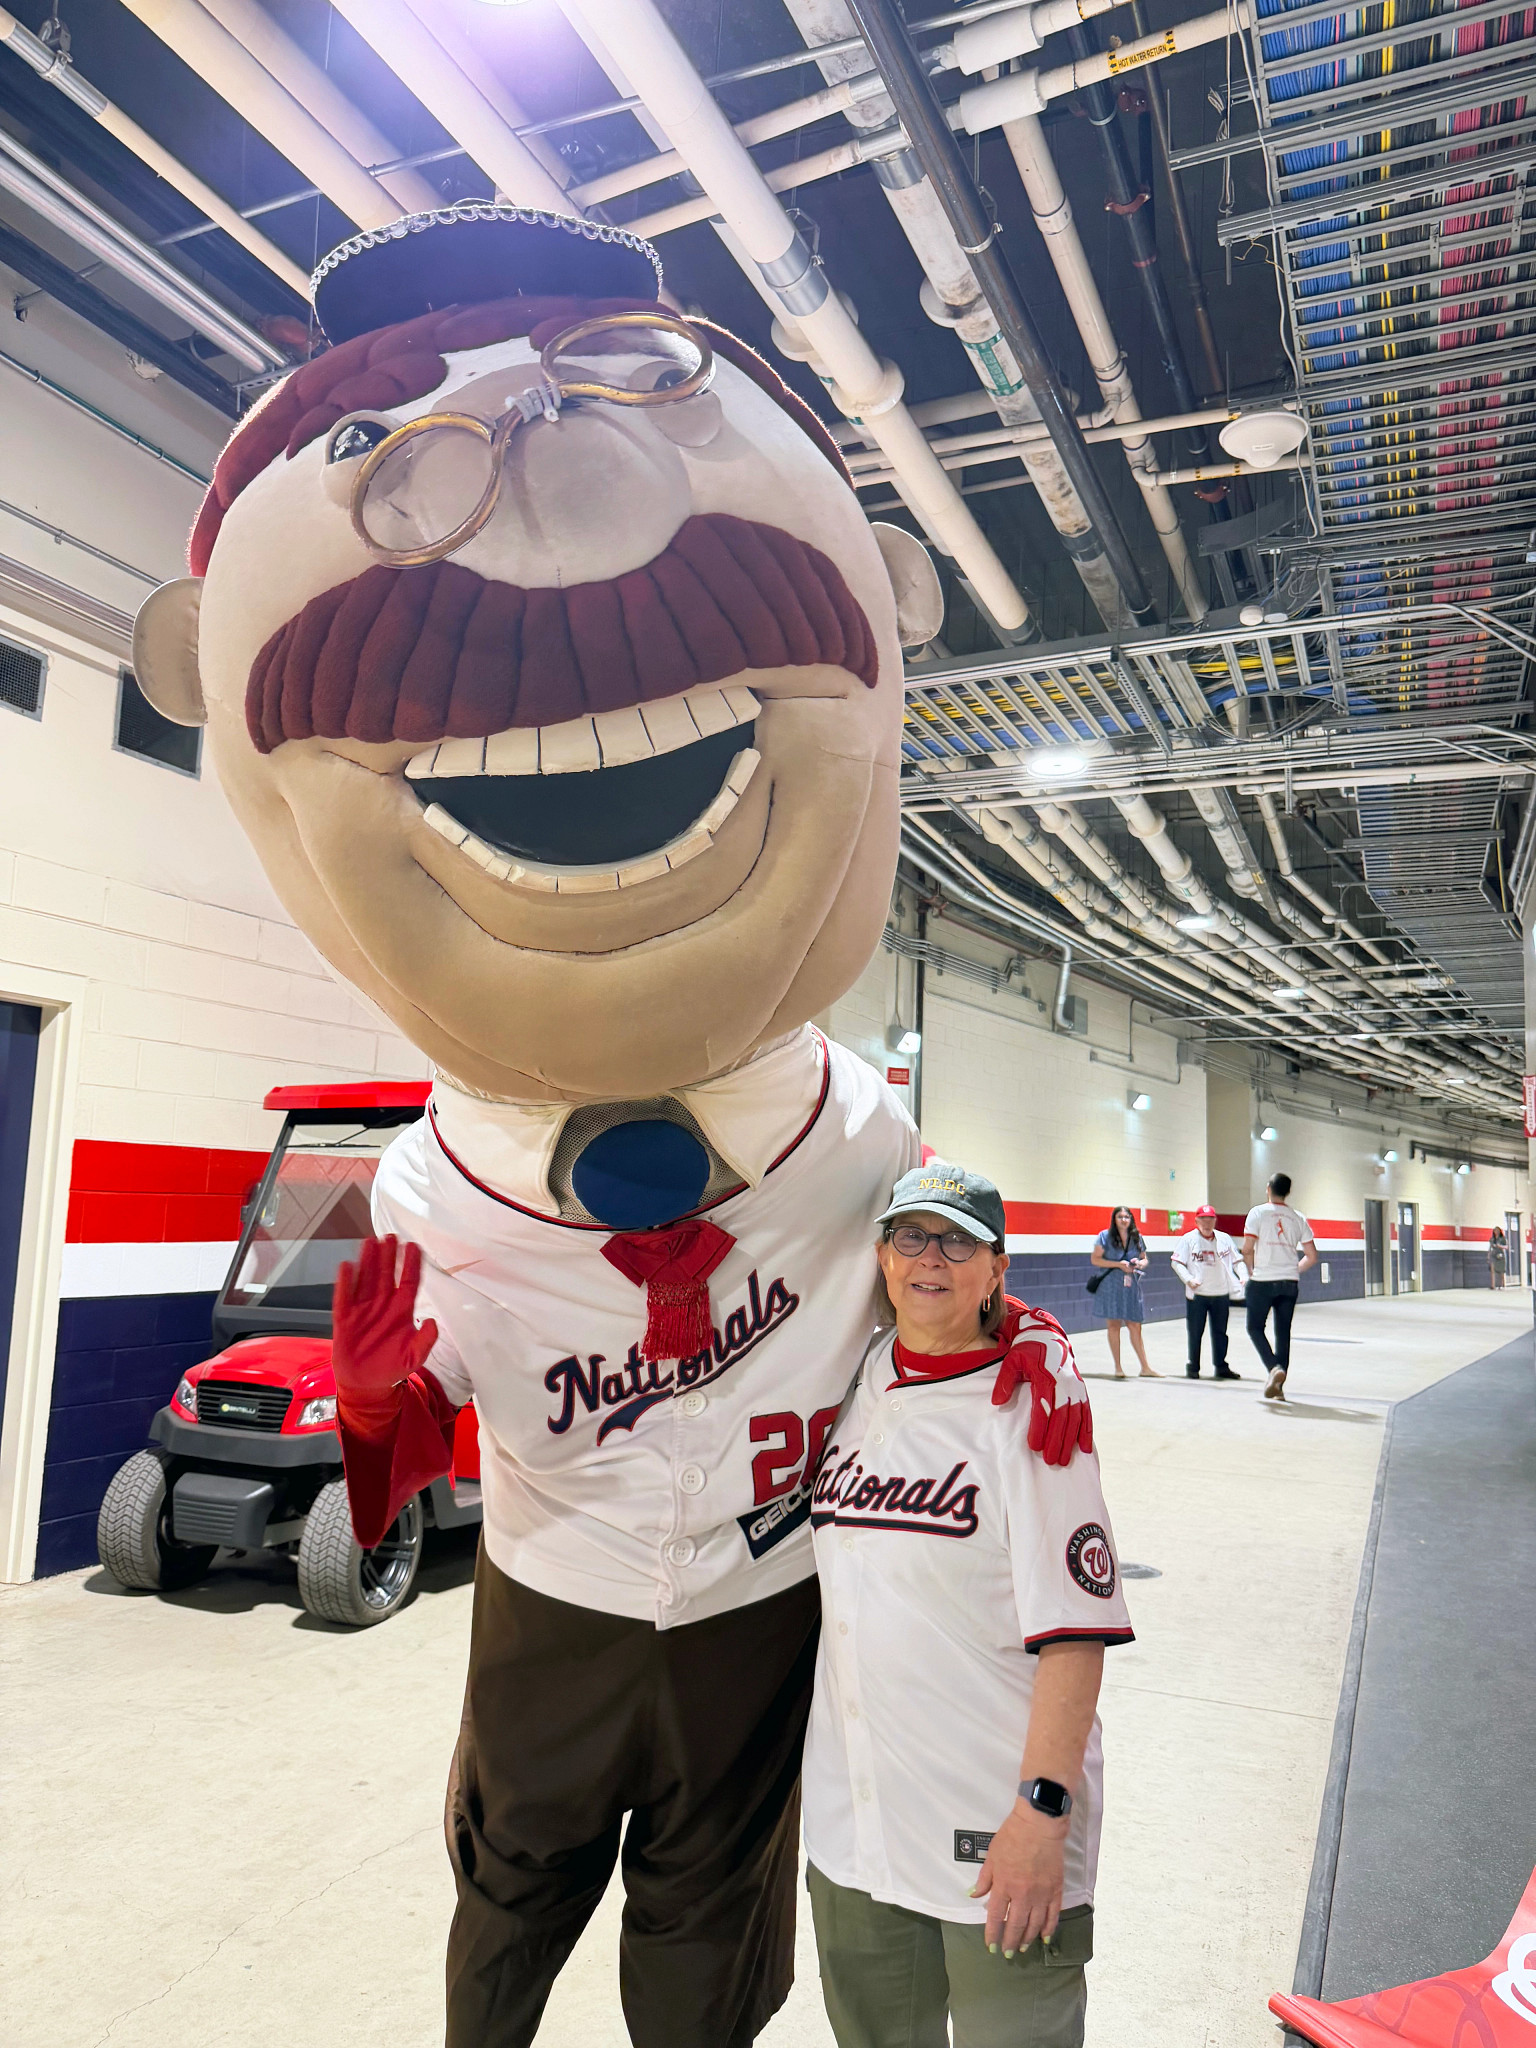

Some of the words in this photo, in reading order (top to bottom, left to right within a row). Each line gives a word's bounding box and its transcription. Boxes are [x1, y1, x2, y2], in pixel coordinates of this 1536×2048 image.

[1118, 58, 1129, 68] HOT
[1129, 51, 1147, 64] WATER
[1147, 45, 1167, 58] RETURN
[813, 1444, 981, 1538] ationals
[1068, 1525, 1109, 1555] WASHINGT
[1077, 1574, 1114, 1596] NATION
